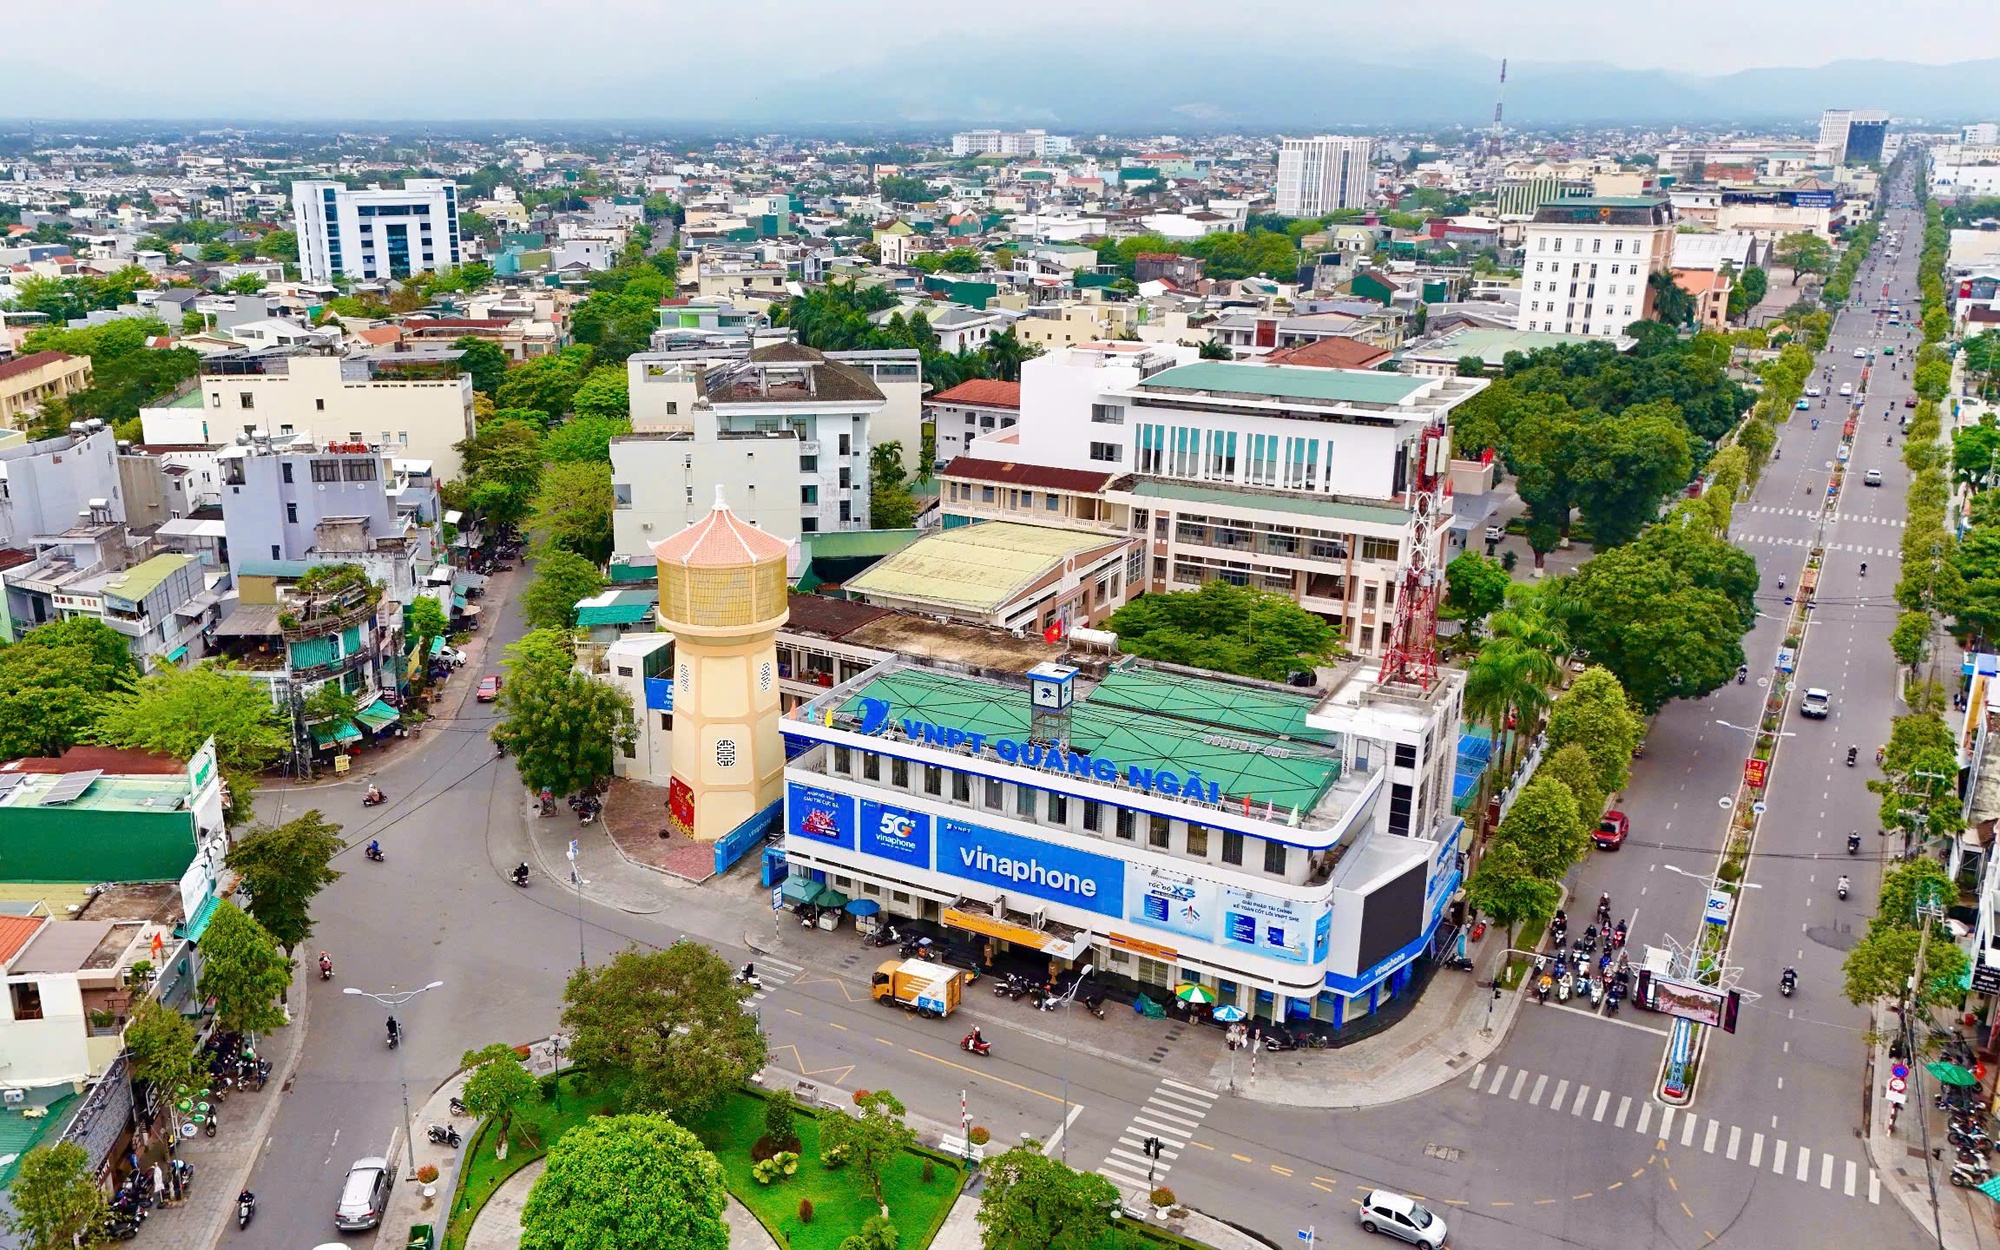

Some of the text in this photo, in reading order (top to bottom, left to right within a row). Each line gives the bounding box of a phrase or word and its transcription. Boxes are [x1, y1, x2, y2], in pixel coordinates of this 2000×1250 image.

[903, 718, 1220, 805] VNPT QUẢNG NGÃI
[875, 833, 916, 849] vinaphone
[960, 845, 1097, 897] vinaphone
